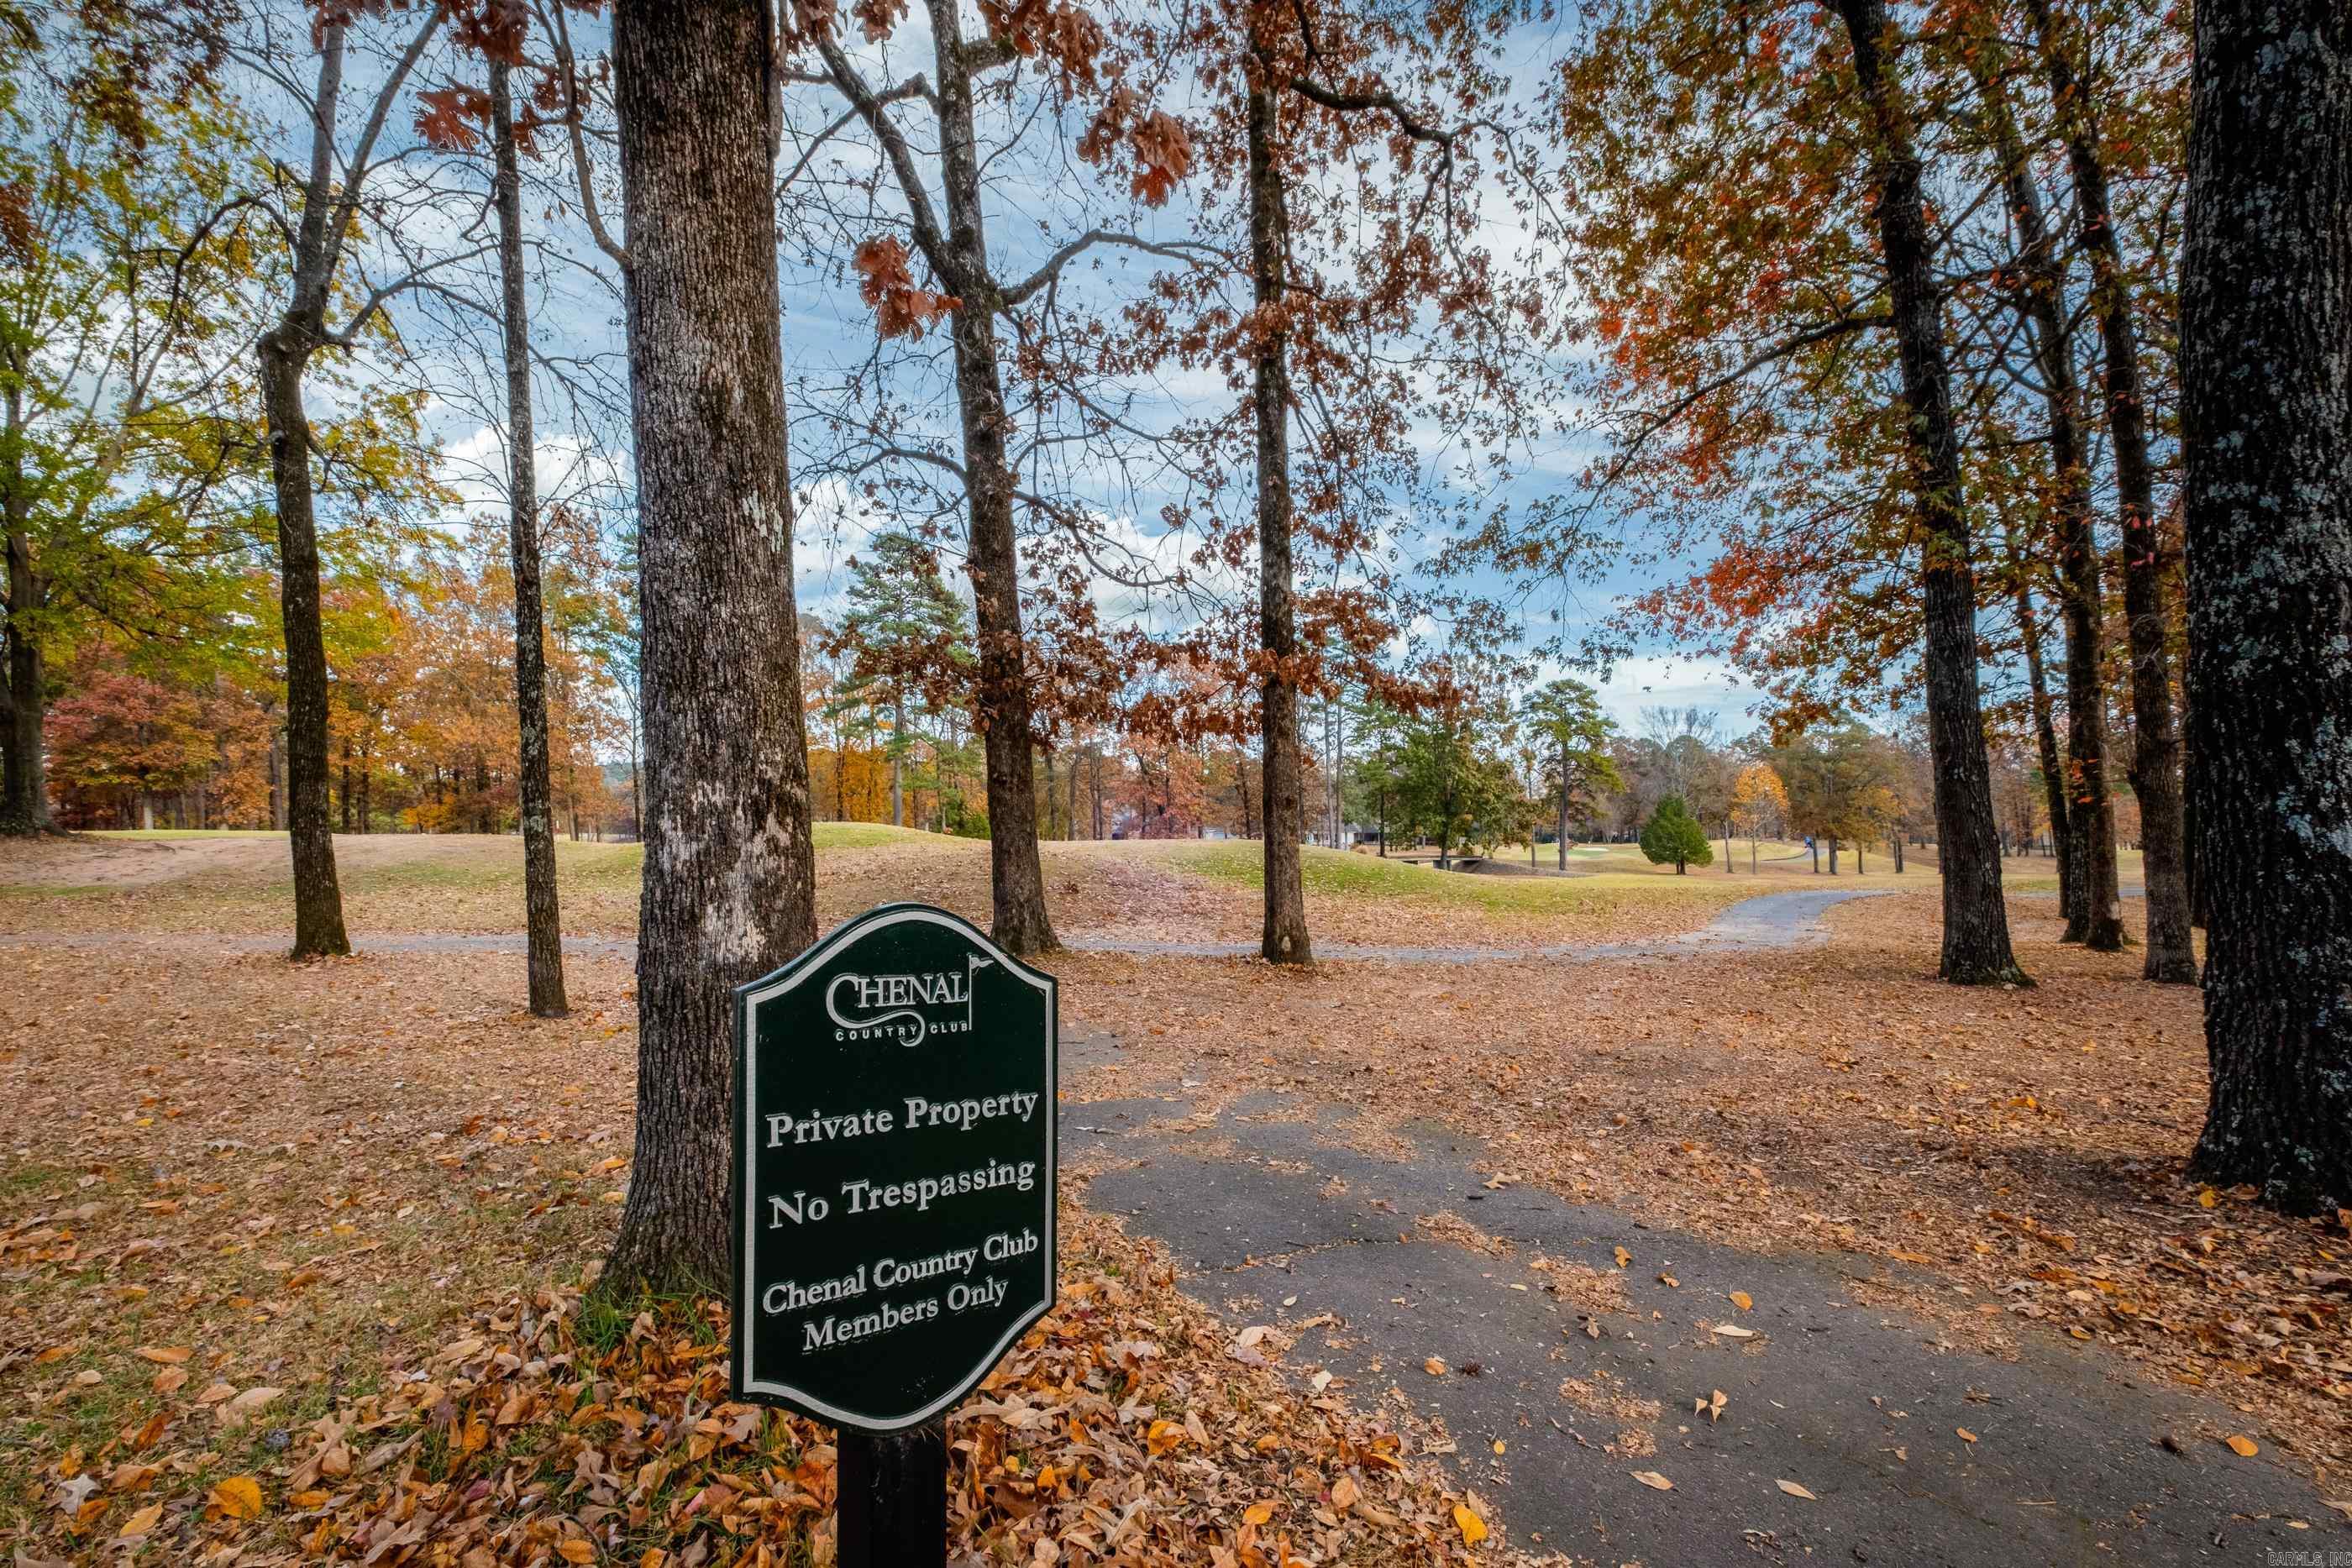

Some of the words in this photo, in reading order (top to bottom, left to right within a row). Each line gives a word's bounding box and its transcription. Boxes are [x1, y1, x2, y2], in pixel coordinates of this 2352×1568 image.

[826, 973, 969, 1029] CHENAL
[836, 1024, 917, 1041] COUNTRY
[930, 1021, 968, 1034] CLUB
[766, 1109, 893, 1148] Private
[904, 1092, 1038, 1131] Property
[768, 1191, 829, 1230] No
[842, 1158, 1035, 1214] Trespassing
[763, 1265, 867, 1314] Chenal
[874, 1248, 978, 1287] Country
[984, 1227, 1038, 1261] Club
[803, 1298, 938, 1350] Members
[948, 1276, 1008, 1310] Only
